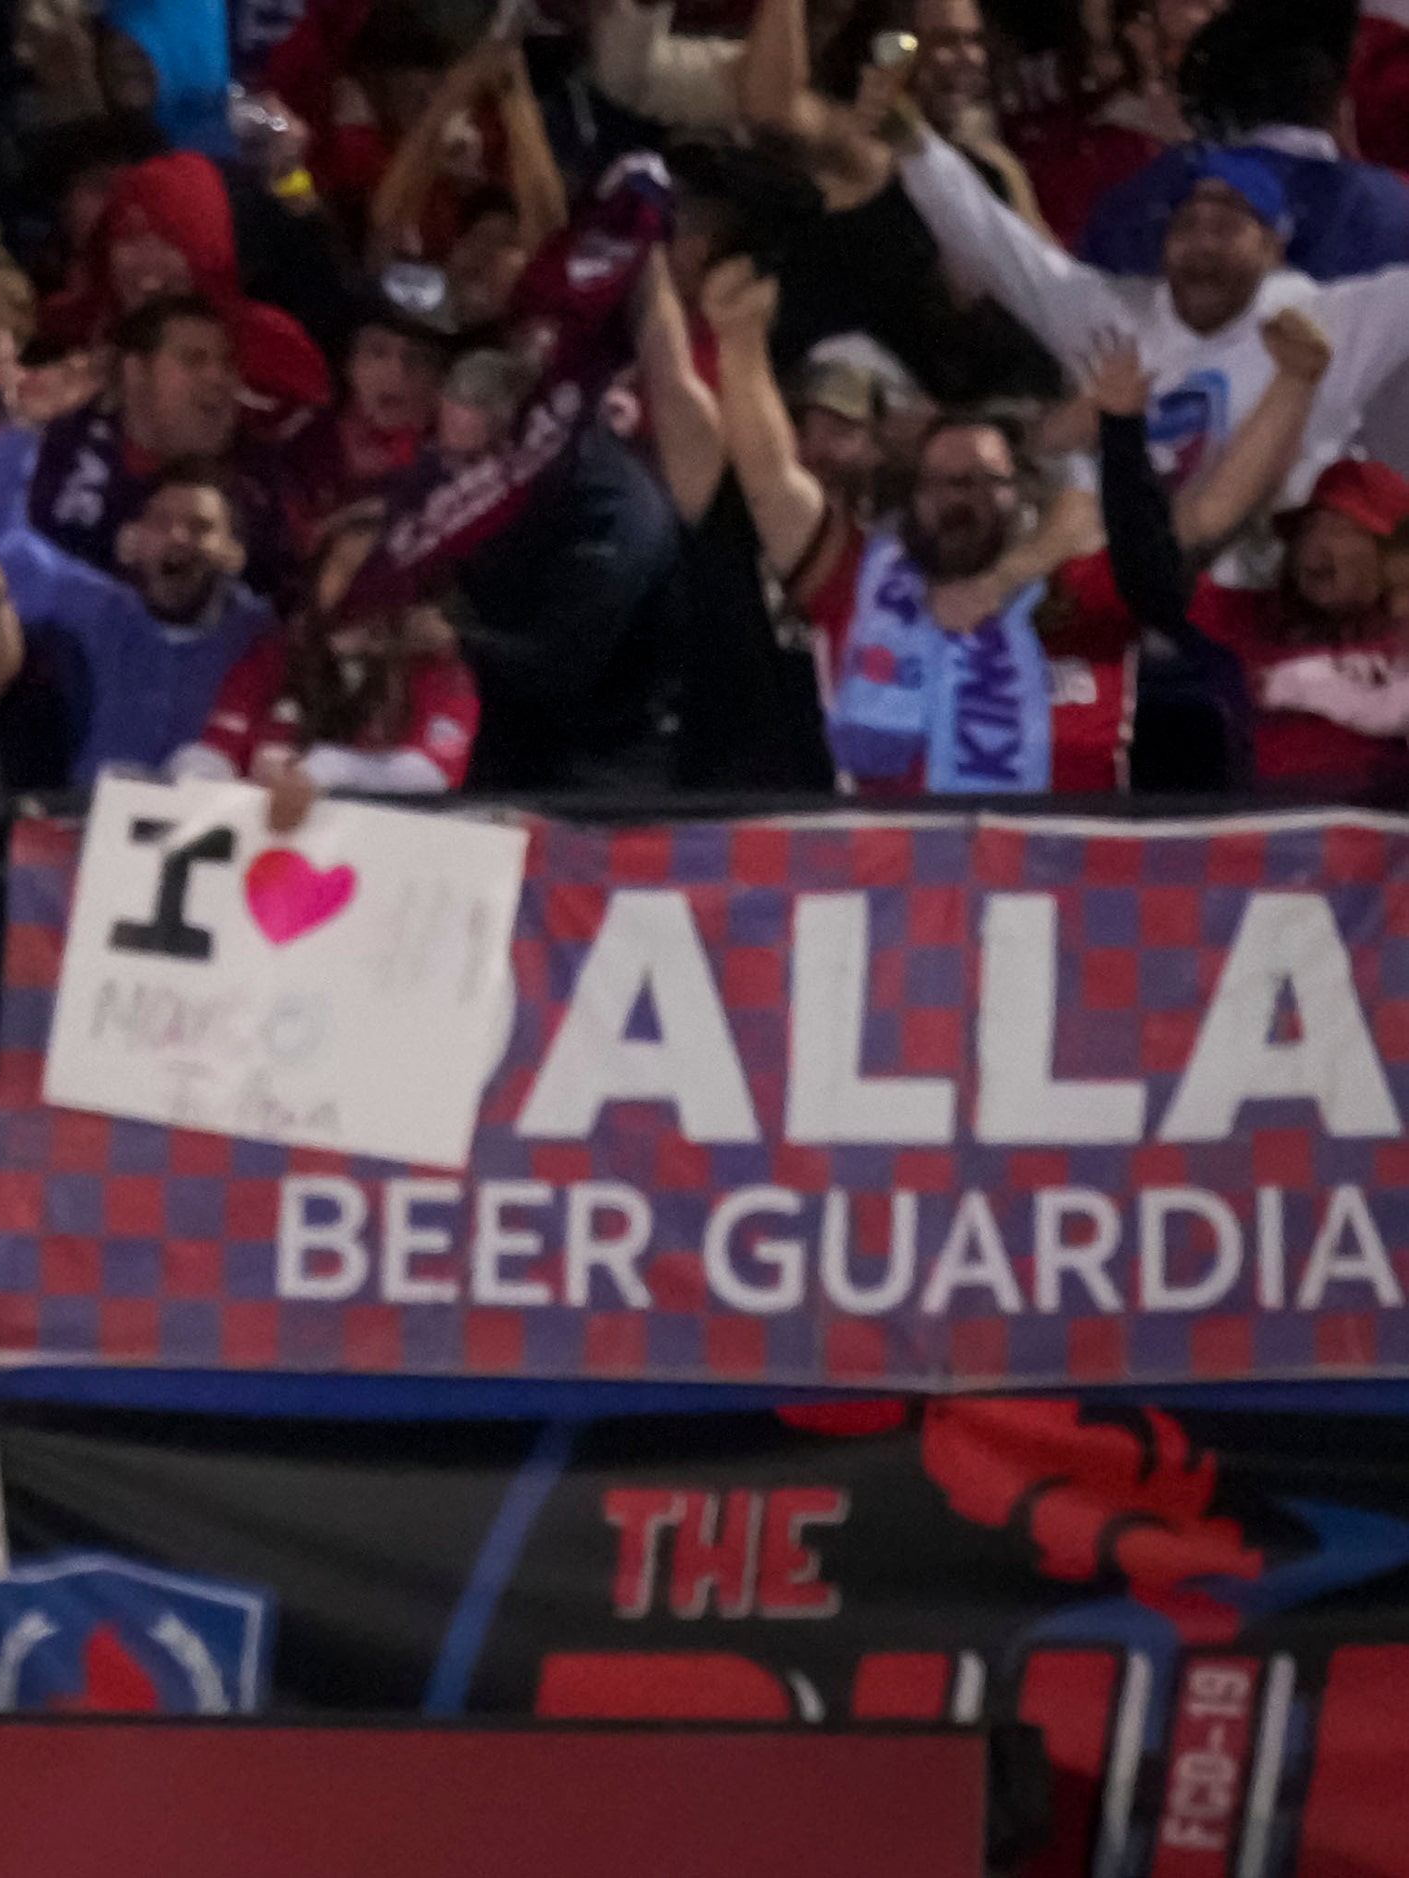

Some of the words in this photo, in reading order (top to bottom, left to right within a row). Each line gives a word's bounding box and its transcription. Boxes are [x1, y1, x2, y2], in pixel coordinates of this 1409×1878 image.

[107, 817, 237, 962] I
[514, 888, 1405, 1146] ALLA
[277, 1173, 656, 1309] BEER
[702, 1182, 1407, 1316] GUARDIA
[602, 1486, 851, 1620] THE
[1158, 1664, 1252, 1854] FCD-19
